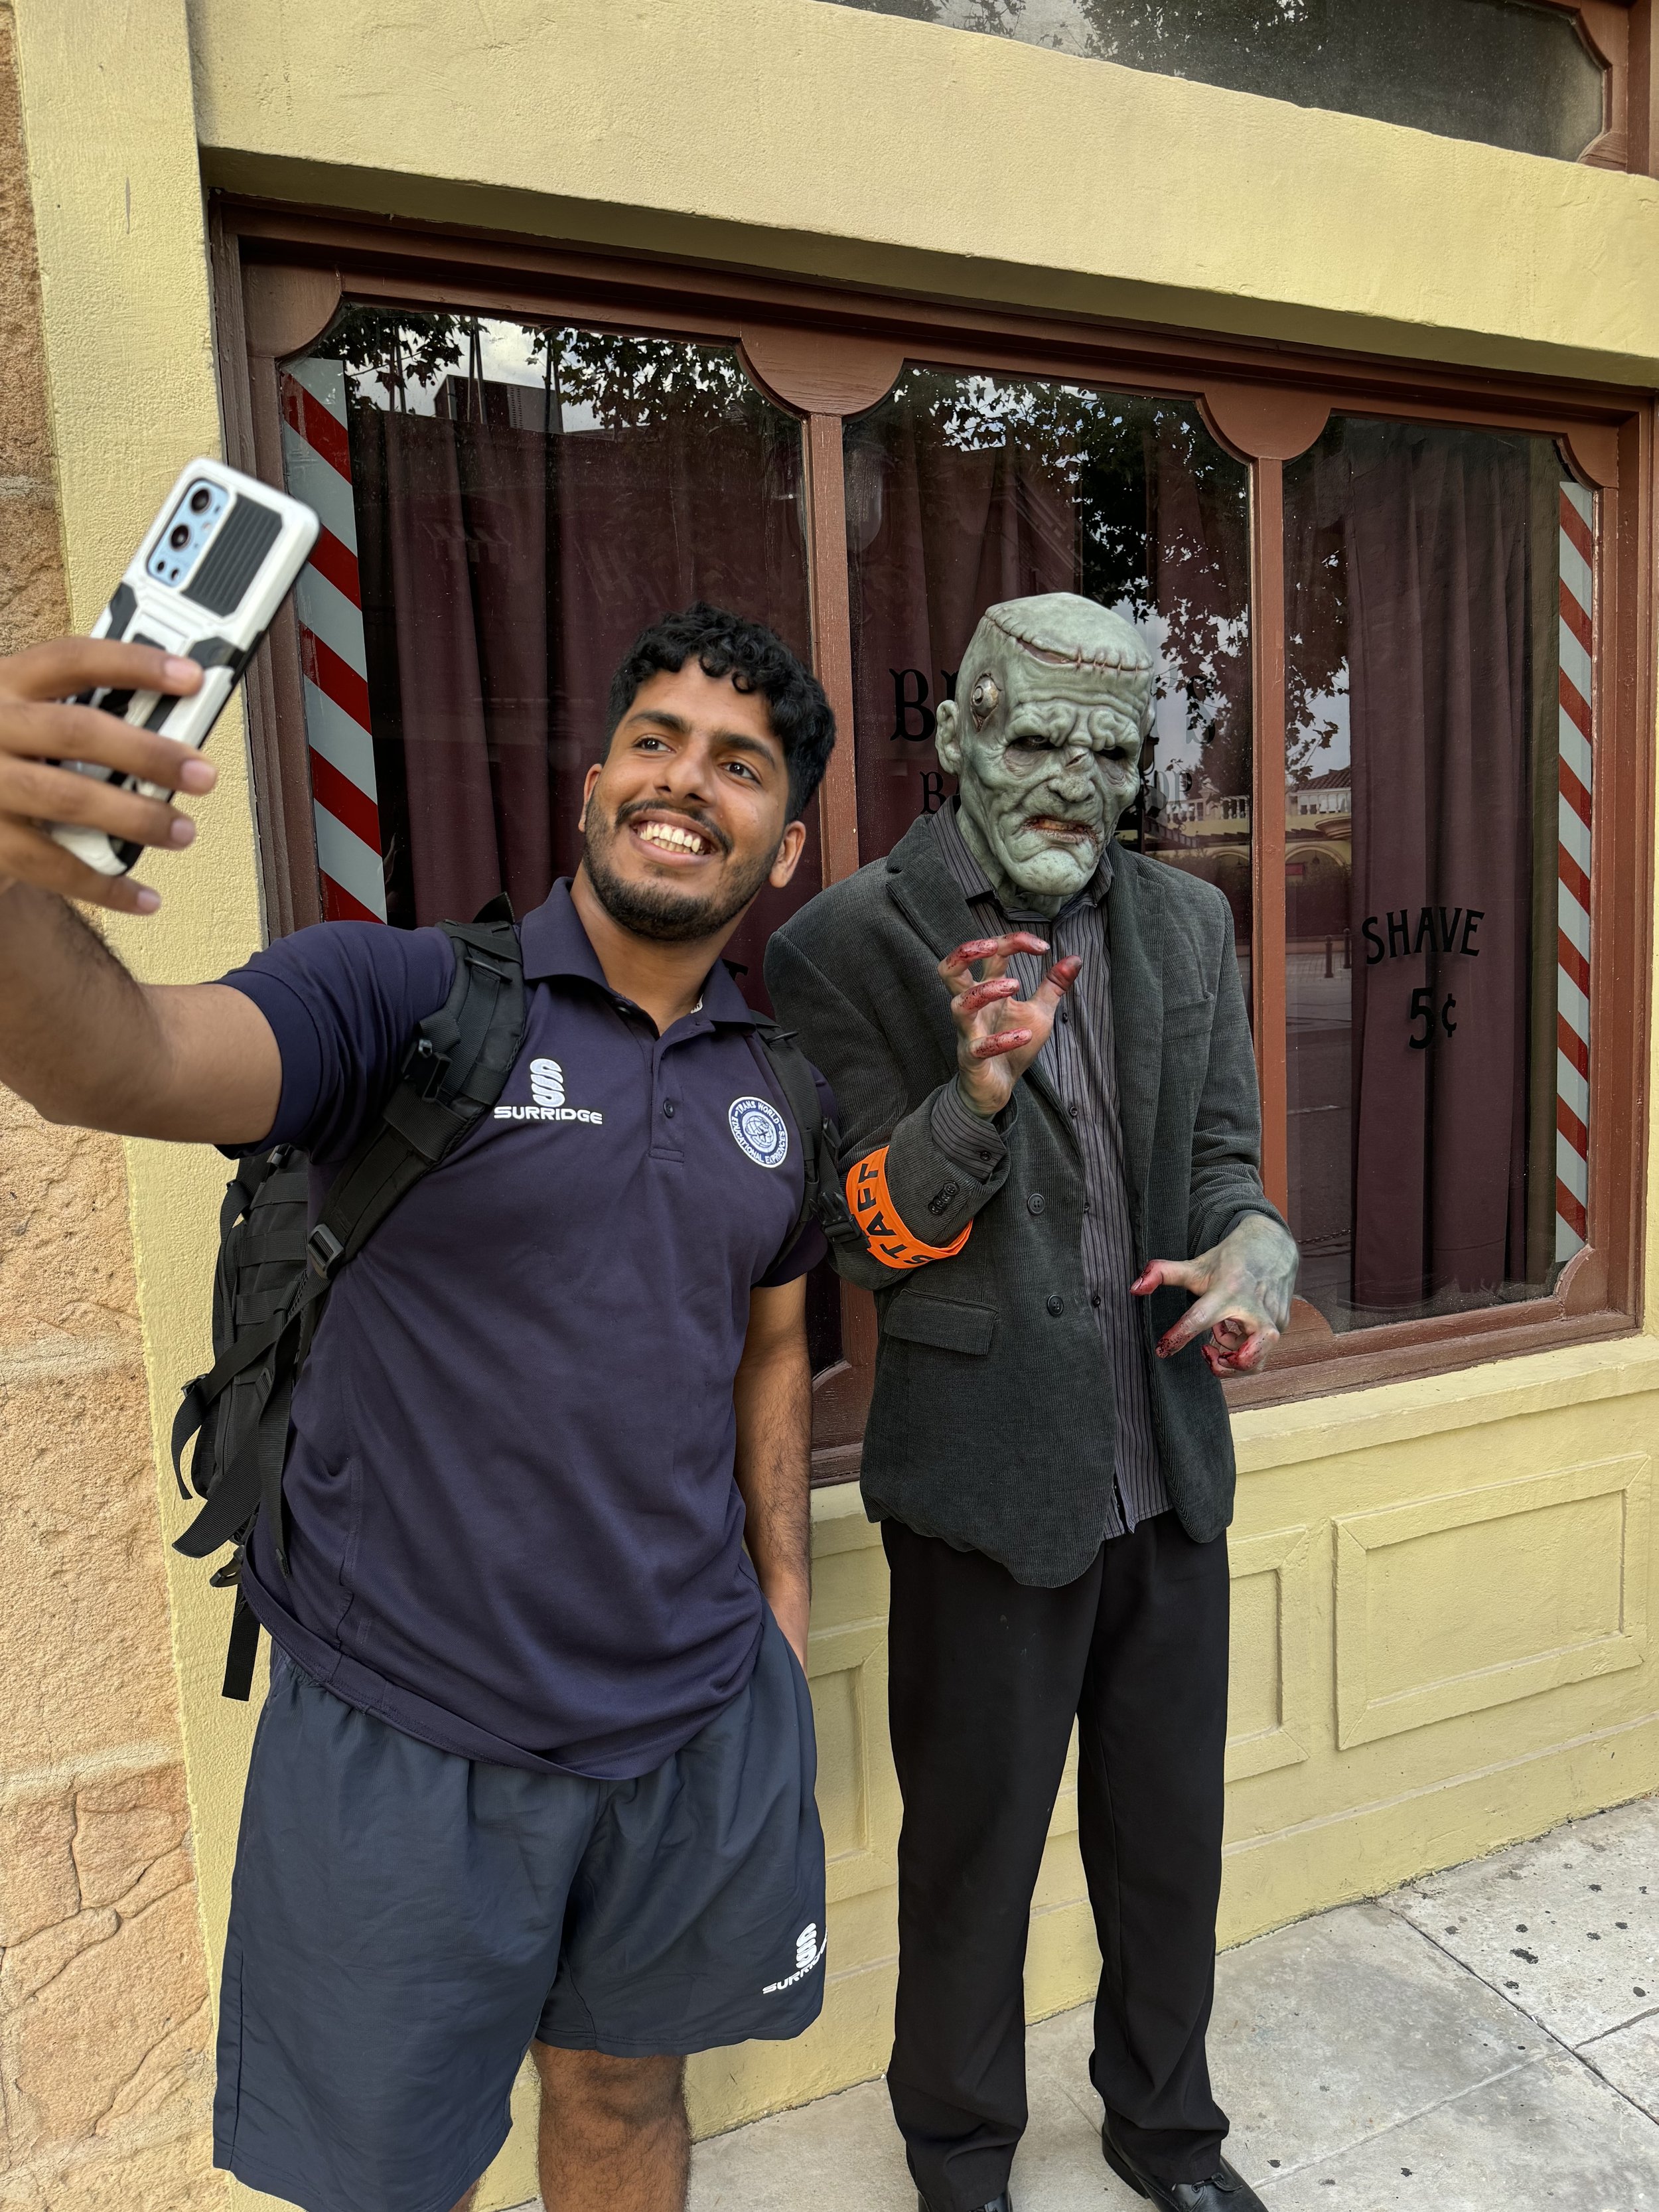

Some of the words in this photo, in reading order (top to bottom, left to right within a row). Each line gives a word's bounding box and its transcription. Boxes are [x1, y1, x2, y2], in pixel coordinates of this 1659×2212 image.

[1362, 907, 1485, 965] SHAVE
[1409, 987, 1457, 1049] 5¢
[494, 1106, 603, 1124] SURRIDGE
[735, 1100, 757, 1114] TRANS
[758, 1102, 780, 1124] WORLD
[731, 1116, 764, 1163] EDUCATIONAL
[857, 1163, 936, 1265] STAFF
